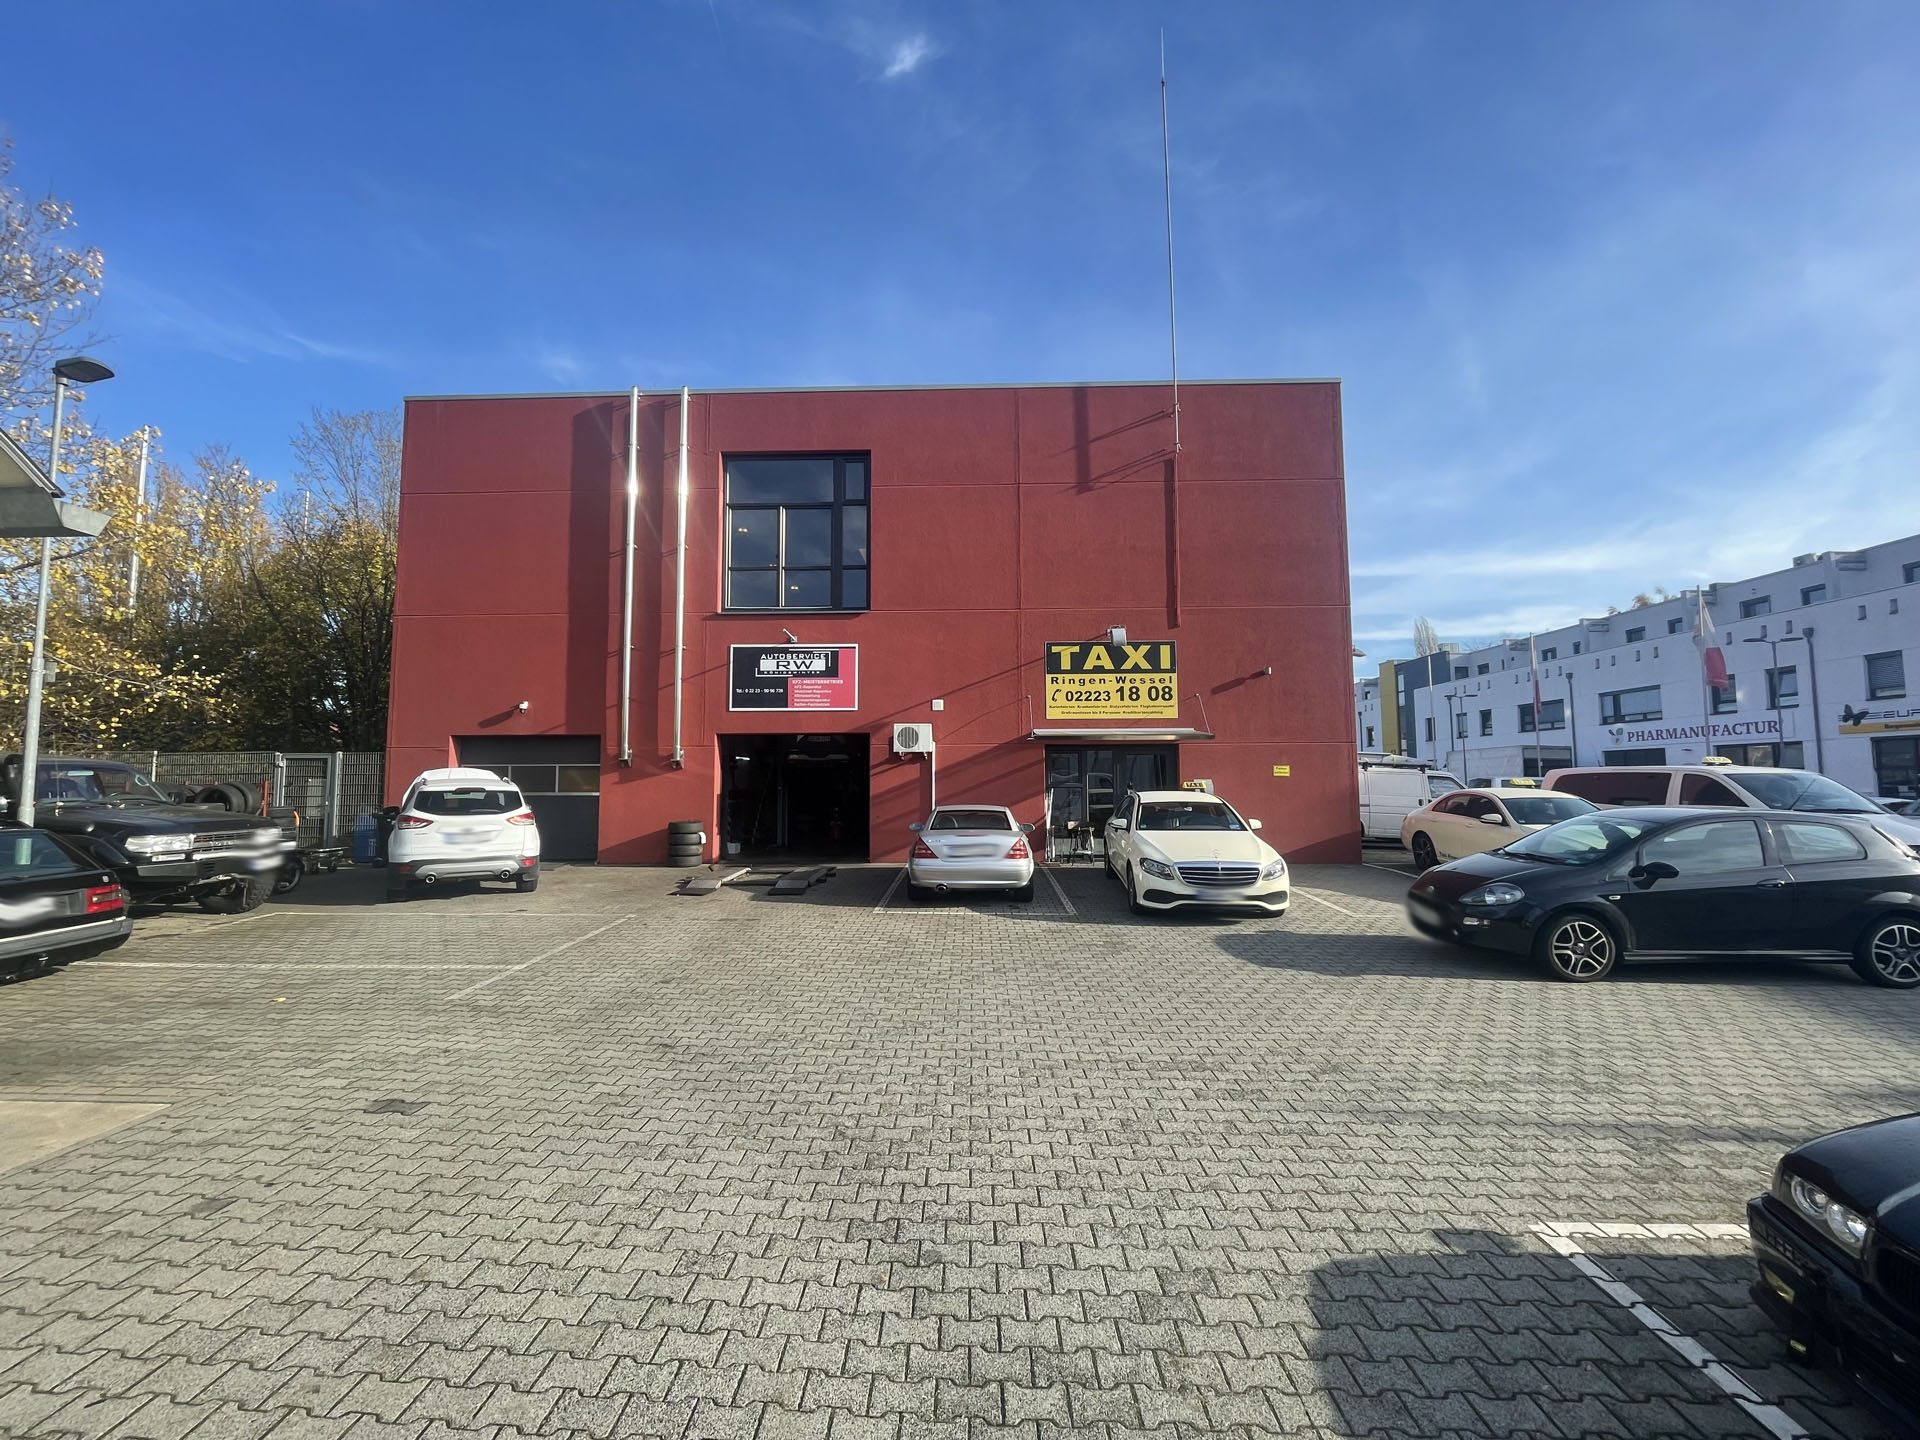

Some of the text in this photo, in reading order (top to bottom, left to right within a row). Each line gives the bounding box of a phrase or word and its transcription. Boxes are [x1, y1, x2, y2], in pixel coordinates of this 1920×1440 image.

[776, 660, 814, 670] RW
[1051, 644, 1171, 671] TAXI
[1051, 676, 1173, 686] Ringen-Wessel
[1065, 685, 1174, 702] 02223 18 08
[1627, 720, 1780, 743] PHARMANUFACTUR
